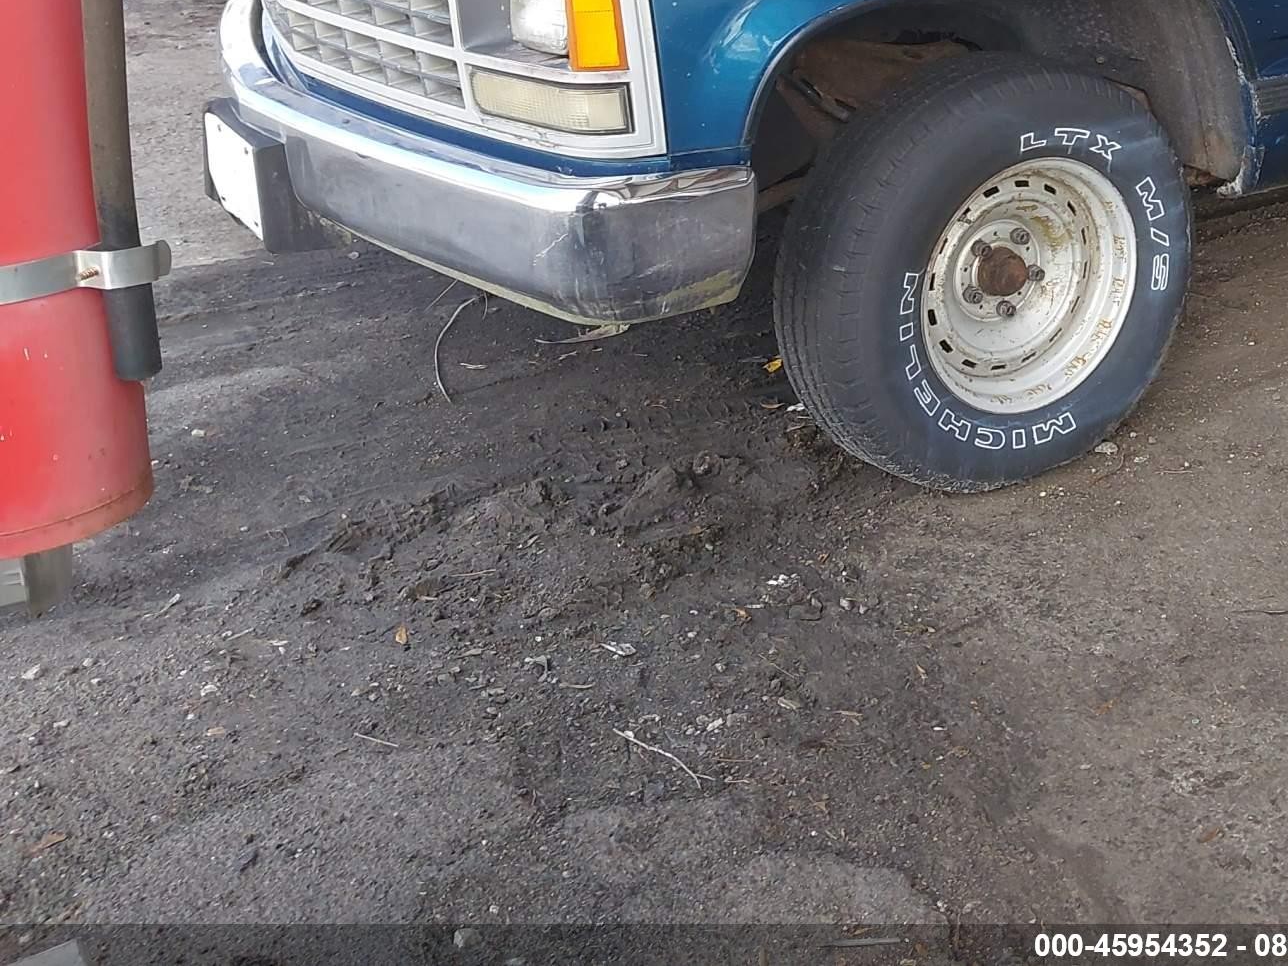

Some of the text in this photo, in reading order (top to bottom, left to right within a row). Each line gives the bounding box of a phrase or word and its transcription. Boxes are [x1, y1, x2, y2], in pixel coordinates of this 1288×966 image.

[1019, 127, 1170, 291] LTX M/S
[899, 272, 1077, 450] MICHELIN
